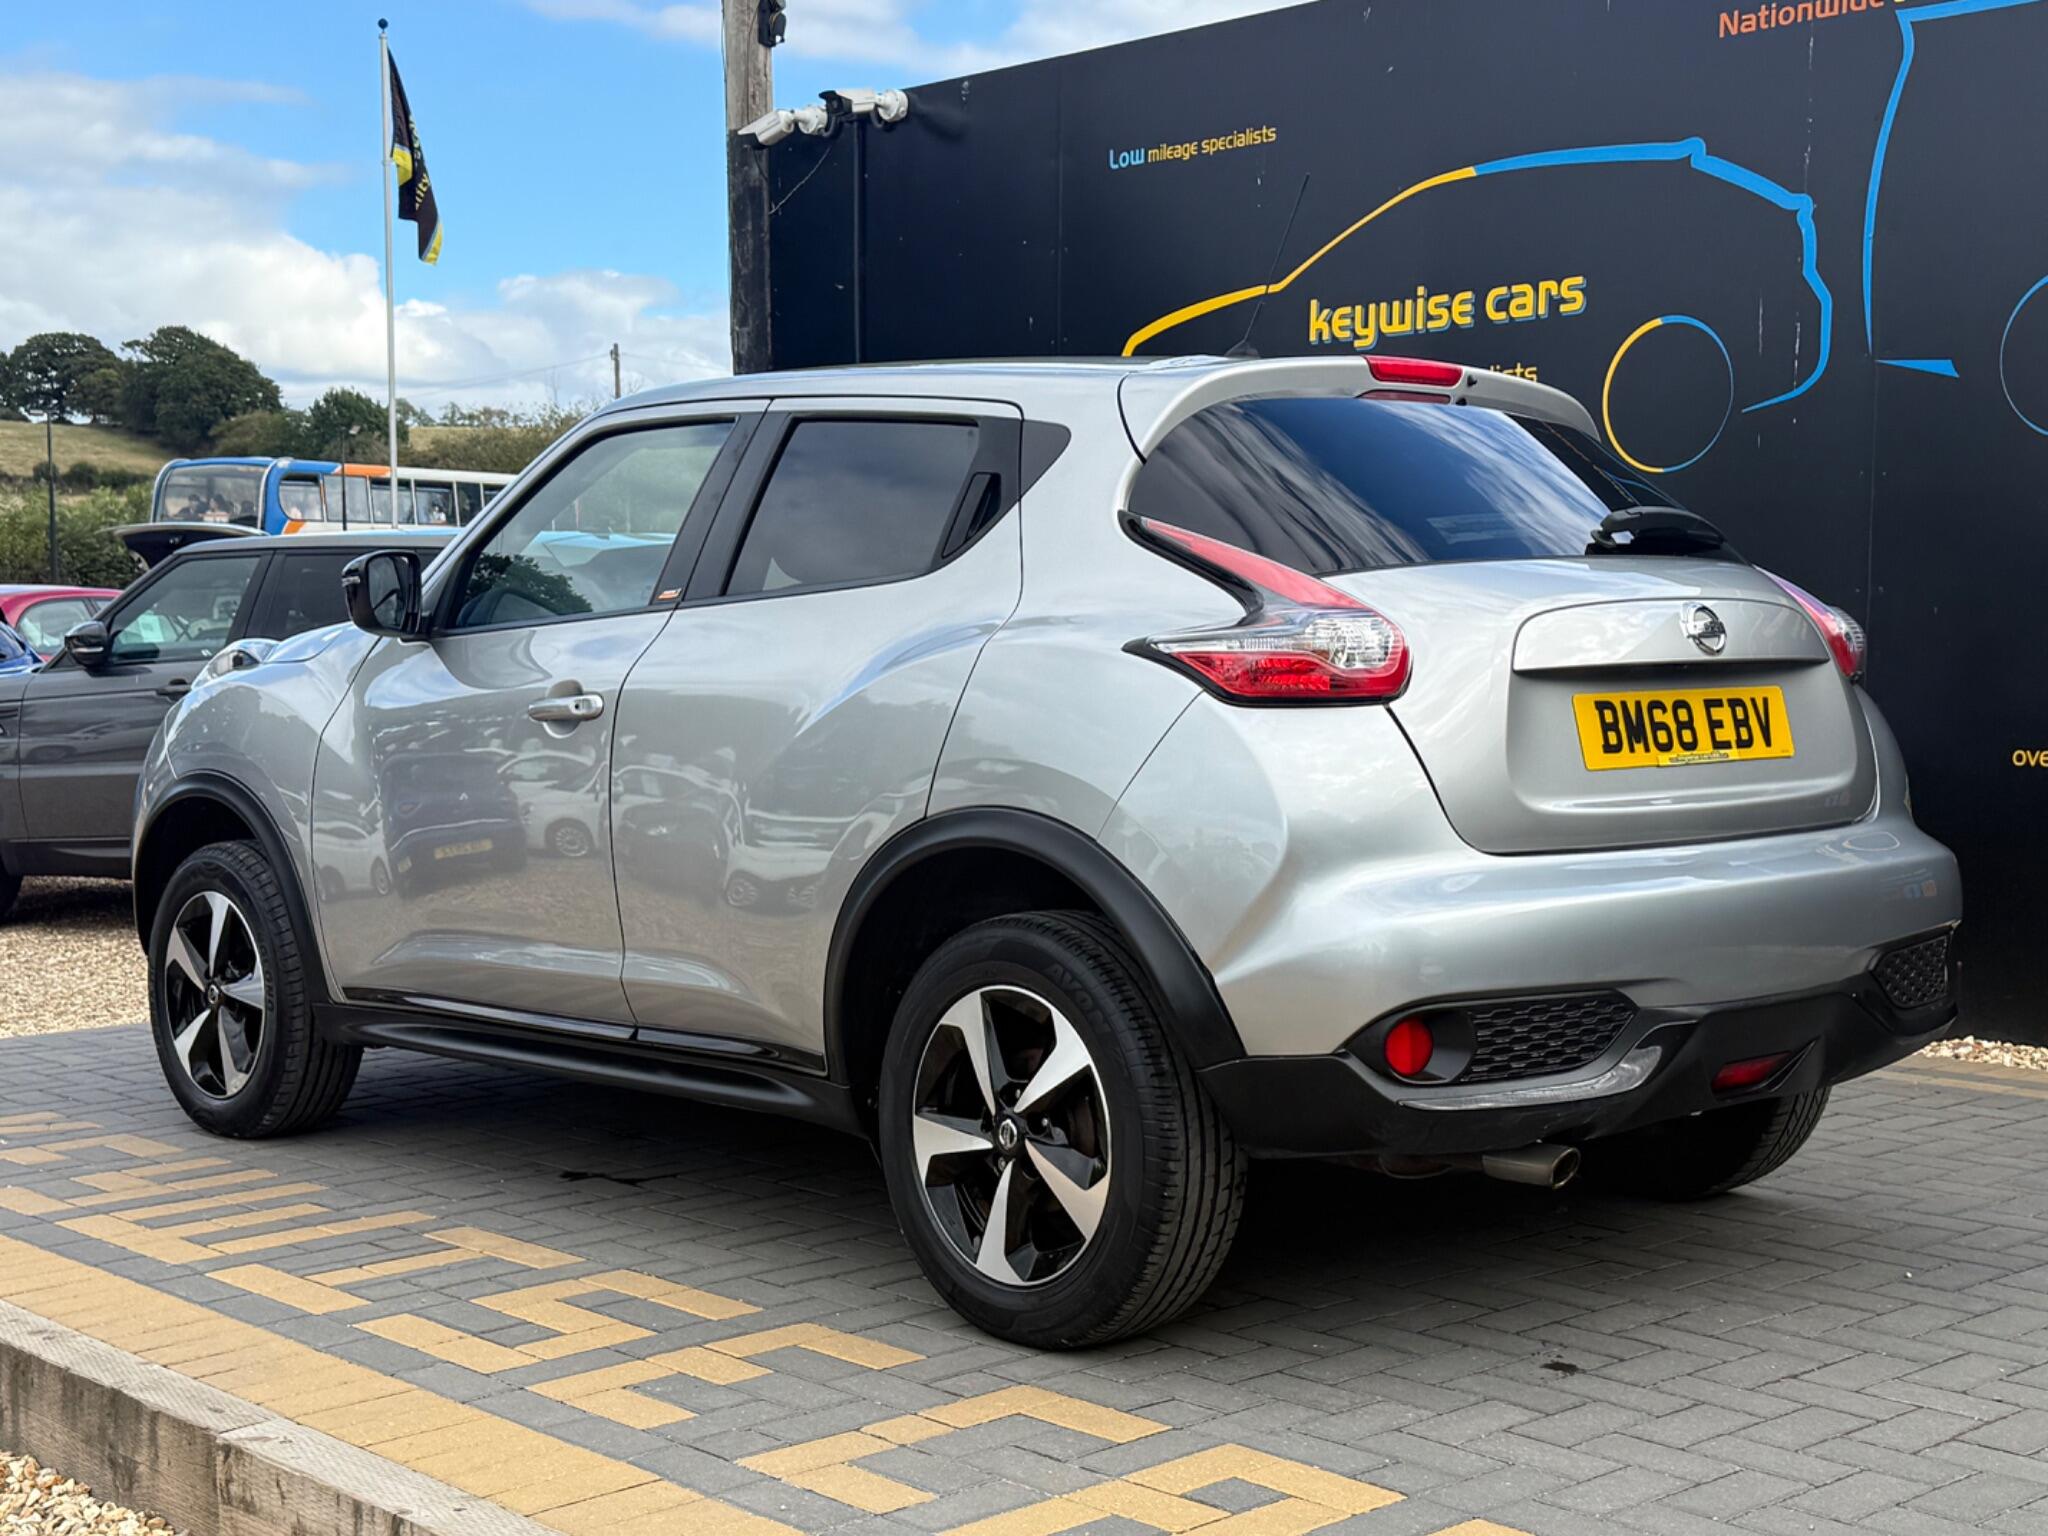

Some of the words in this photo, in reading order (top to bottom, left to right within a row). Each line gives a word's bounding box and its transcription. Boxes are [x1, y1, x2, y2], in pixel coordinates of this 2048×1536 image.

[1109, 148, 1145, 170] Low
[1148, 143, 1199, 163] mileage
[1201, 124, 1277, 156] specialists
[1308, 285, 1476, 351] keywise
[1485, 275, 1587, 323] cars
[1594, 699, 1699, 754] BM68
[1703, 697, 1772, 750] EBV
[1043, 963, 1112, 1034] AVON
